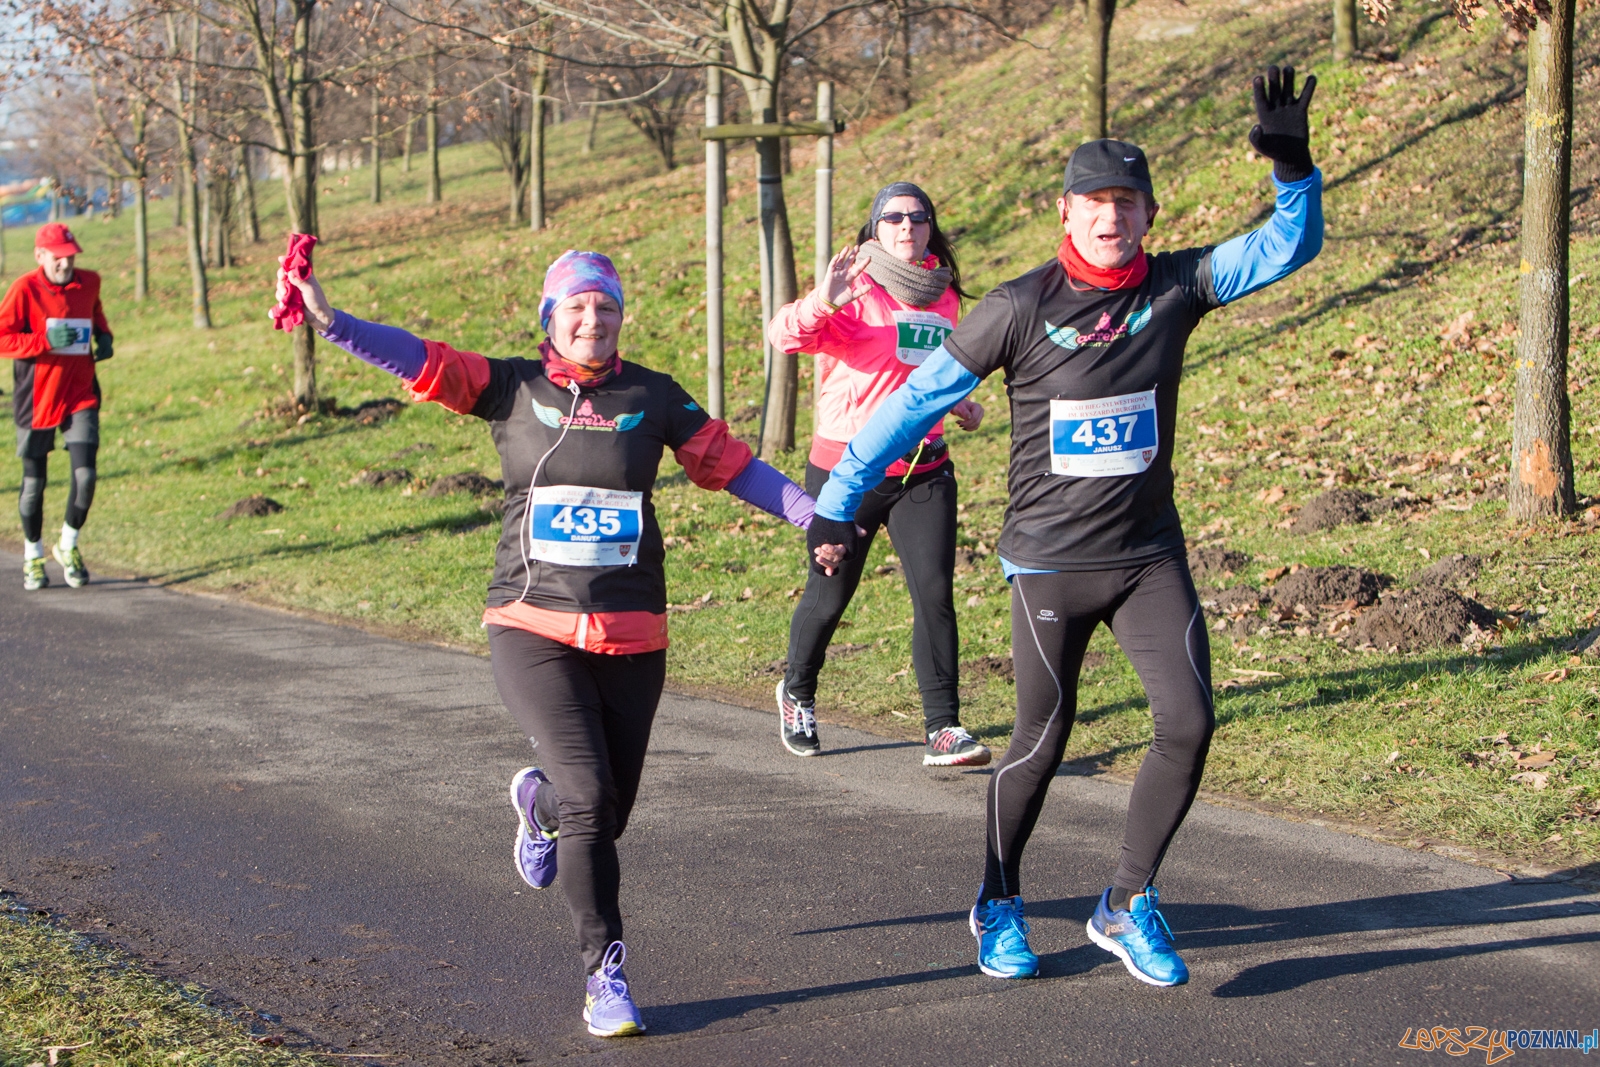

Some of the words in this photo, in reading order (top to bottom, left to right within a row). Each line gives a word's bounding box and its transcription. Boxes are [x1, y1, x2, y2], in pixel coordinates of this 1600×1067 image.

[909, 323, 946, 345] 771
[1080, 408, 1115, 418] RYSZARDA
[1115, 403, 1147, 413] BURGIELA
[1085, 402, 1101, 412] BIEG
[1101, 395, 1148, 408] SYLWESTROWY
[1071, 414, 1138, 447] 437
[1092, 444, 1123, 454] JANUSZ
[550, 506, 622, 536] 435
